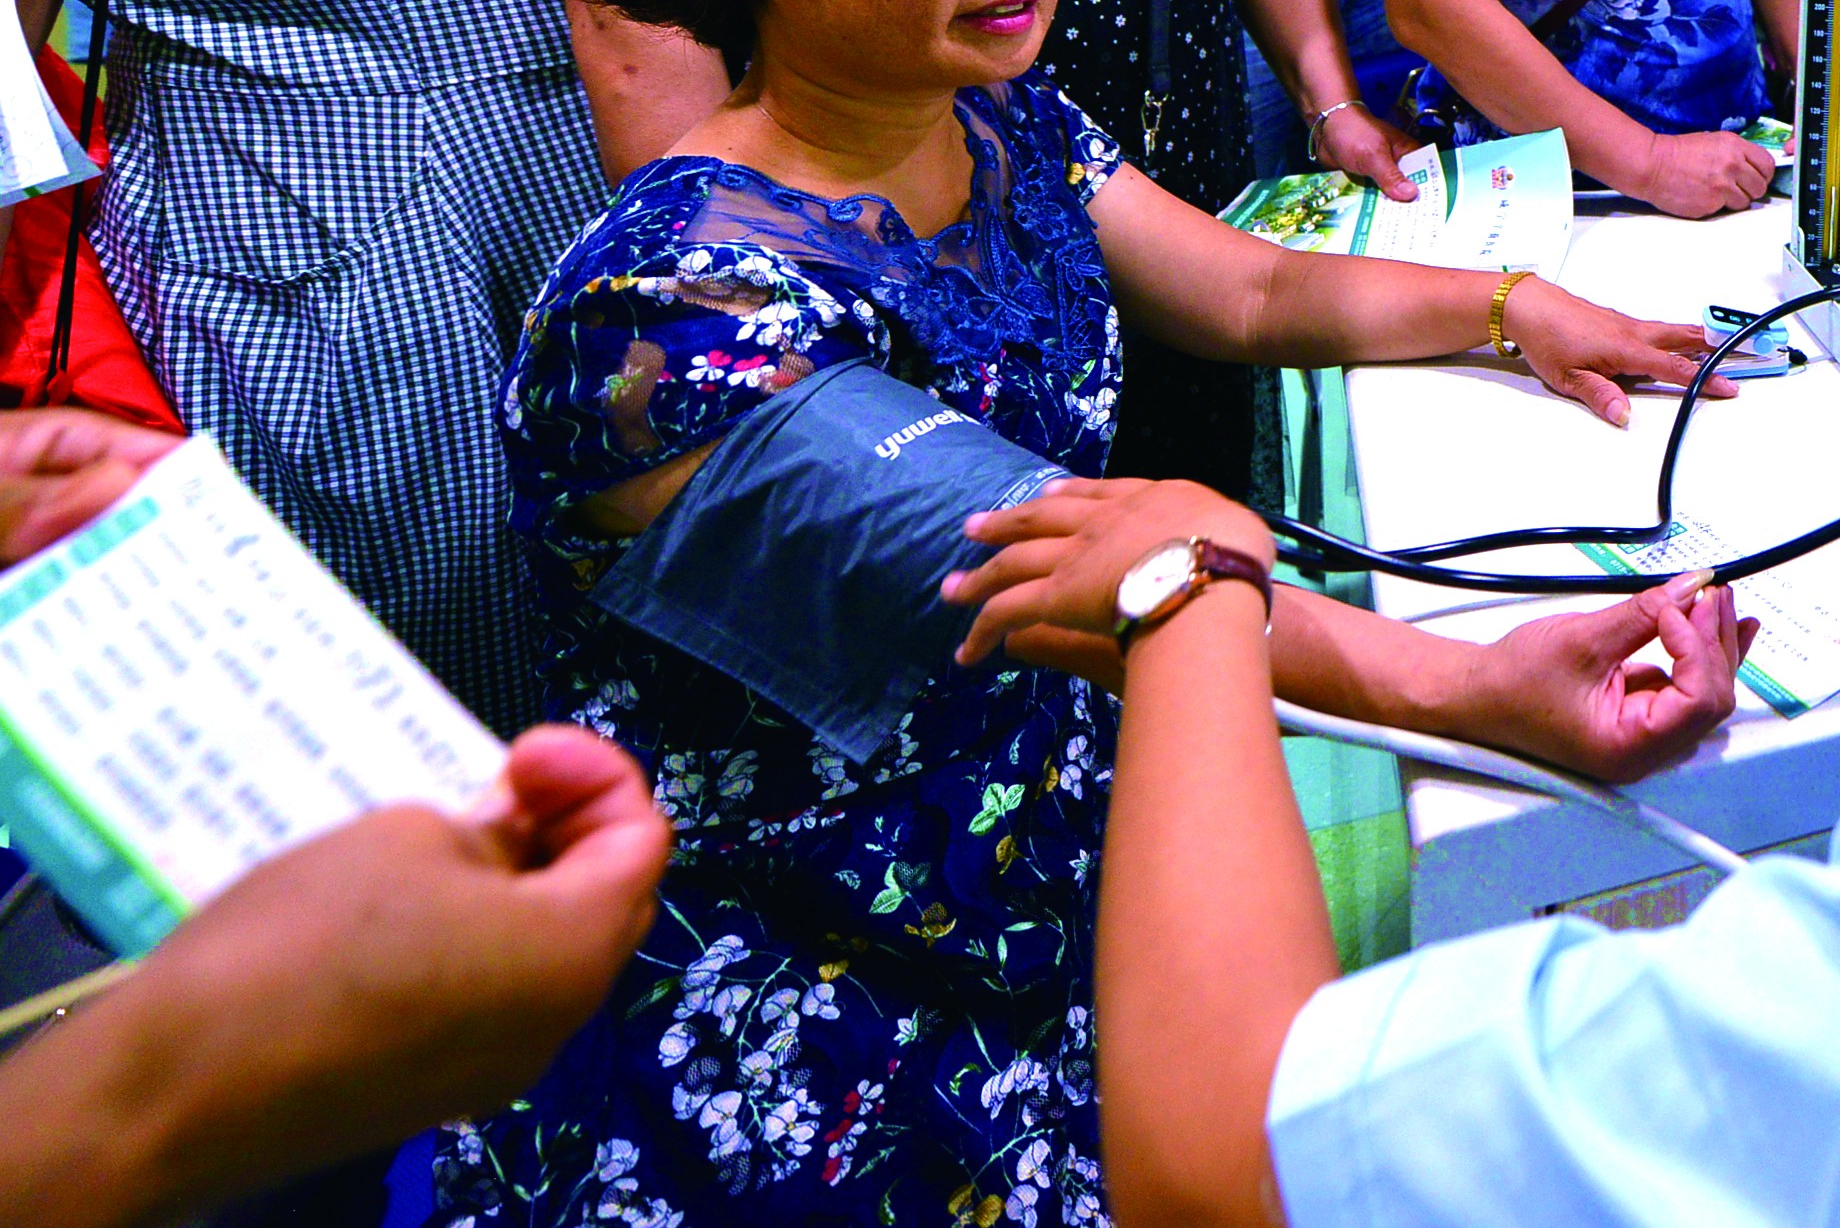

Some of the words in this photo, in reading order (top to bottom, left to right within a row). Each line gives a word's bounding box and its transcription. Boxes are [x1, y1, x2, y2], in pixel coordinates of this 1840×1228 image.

[1814, 3, 1825, 11] 200
[1811, 81, 1822, 89] 140
[1810, 107, 1821, 115] 120
[875, 410, 963, 460] yuwell
